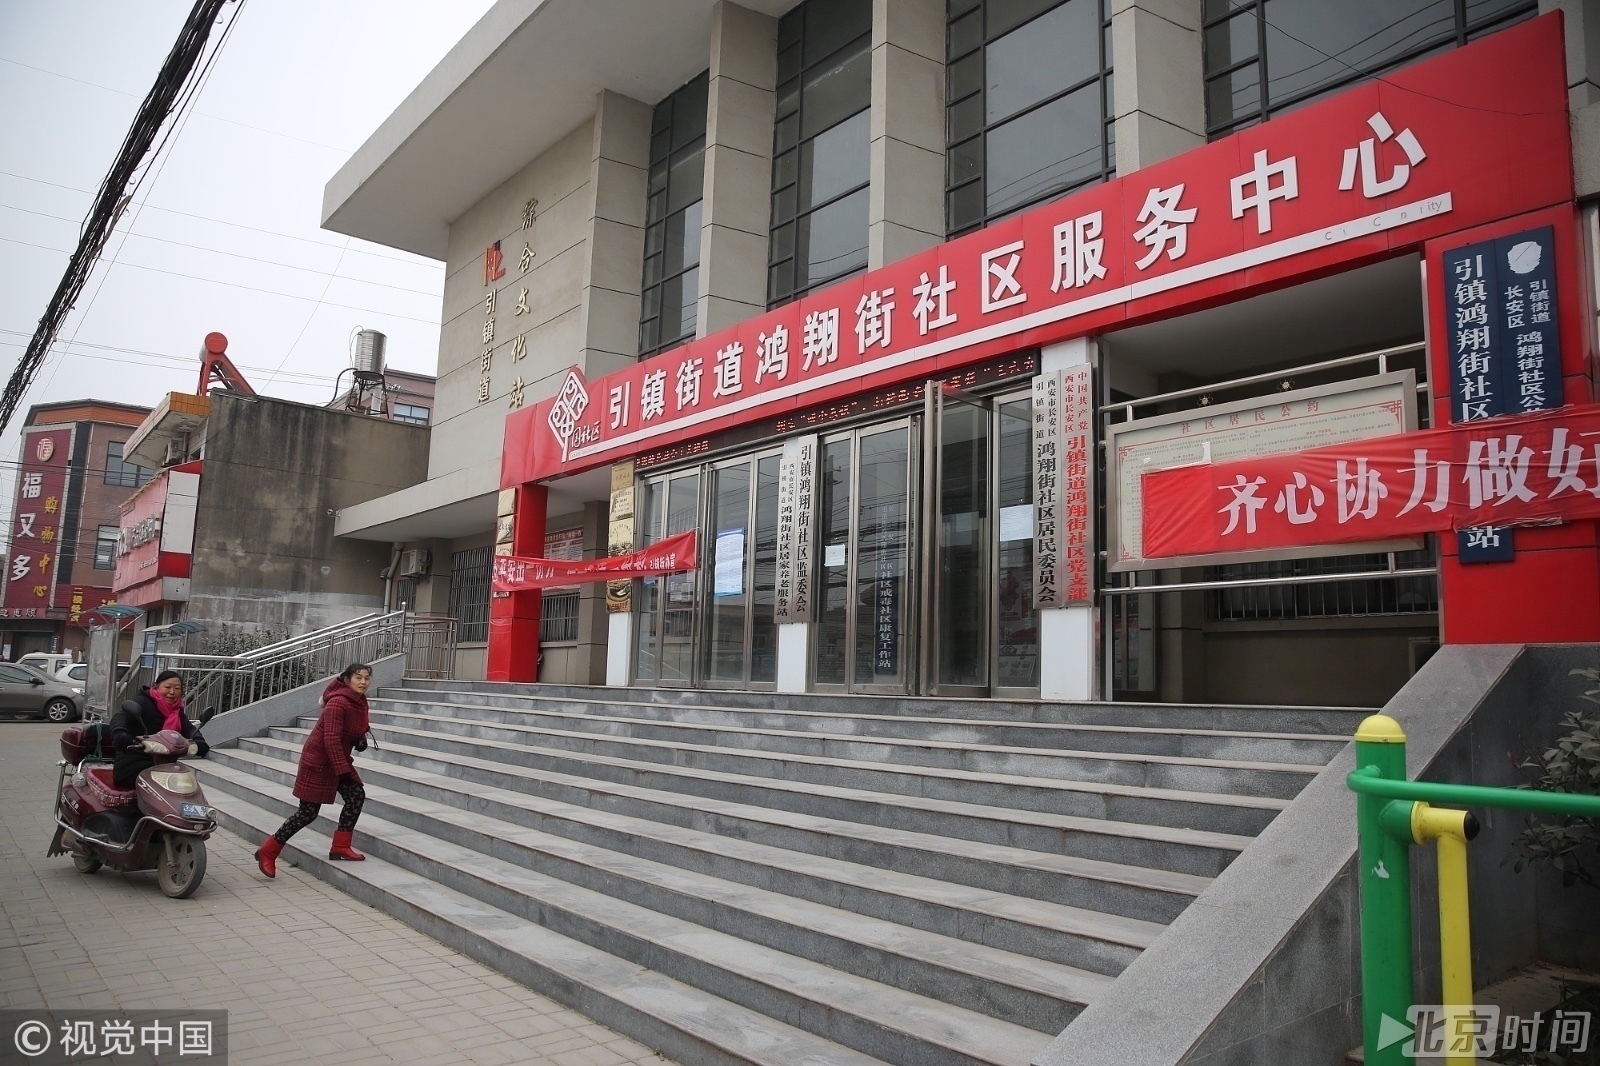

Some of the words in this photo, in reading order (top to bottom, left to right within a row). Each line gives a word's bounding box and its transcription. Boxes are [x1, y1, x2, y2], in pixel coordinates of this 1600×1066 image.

[609, 112, 1427, 430] 引镇街道鸿翔街社区服务中心
[1505, 285, 1525, 329] 长安区
[1529, 279, 1551, 324] 引镇街道
[478, 289, 497, 403] 引镇街道
[1454, 255, 1493, 422] 引镇鸿翔街社区
[1035, 381, 1045, 439] 引镇街道
[1047, 378, 1057, 437] 西安市长安区
[1064, 374, 1074, 434] 西安市长安区
[1077, 371, 1088, 432] 中国共产党
[1181, 401, 1319, 434] 社区居民公约
[11, 472, 43, 581] 福又多
[33, 496, 58, 598] 购物中心
[776, 505, 793, 617] 鸿翔街社区居家养老服务站
[795, 444, 812, 613] 引镇鸿翔街社区监委会
[1037, 441, 1057, 602] 鸿翔街社区居民委员会
[1066, 435, 1088, 601] 引镇街道鸿翔街社区党支部
[1467, 526, 1500, 548] 站
